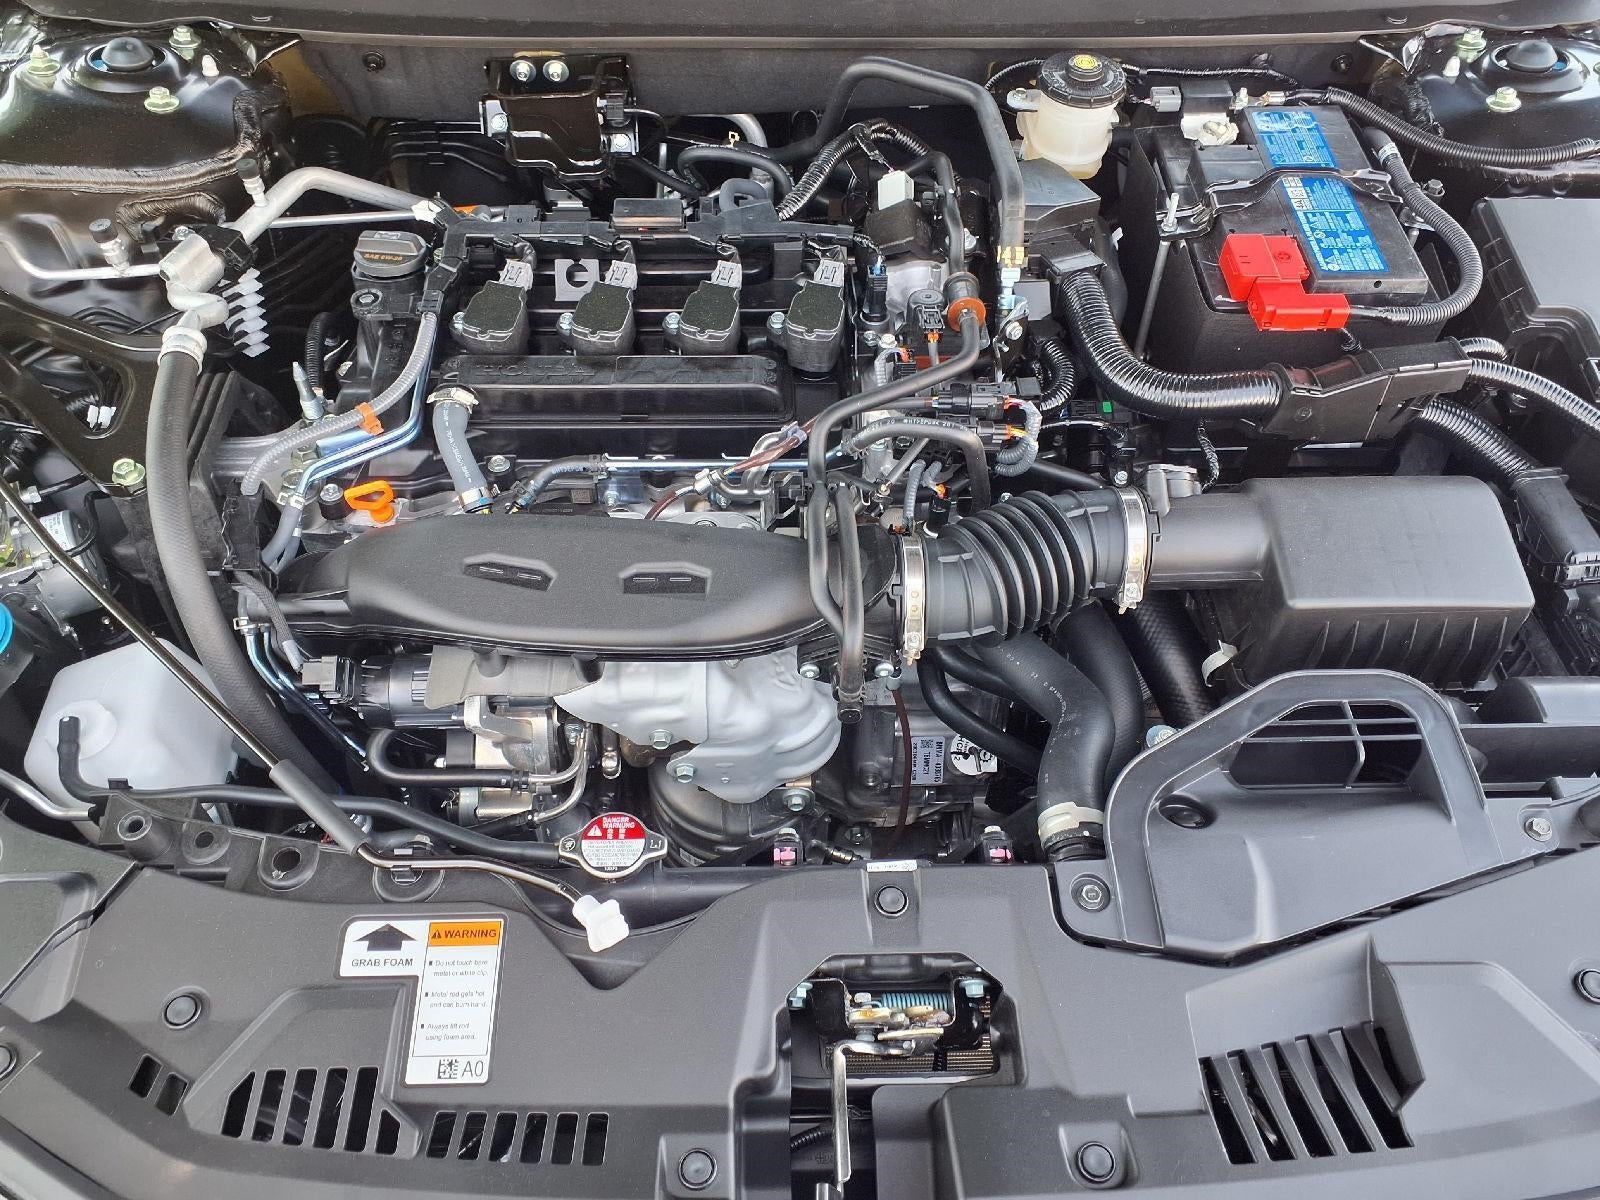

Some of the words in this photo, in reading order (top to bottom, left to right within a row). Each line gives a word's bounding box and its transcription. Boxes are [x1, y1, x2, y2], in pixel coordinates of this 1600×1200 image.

[444, 928, 497, 939] WARNING
[351, 958, 381, 967] GRAB
[383, 957, 414, 967] FOAM
[425, 1034, 443, 1042] using
[461, 1060, 484, 1077] A0
